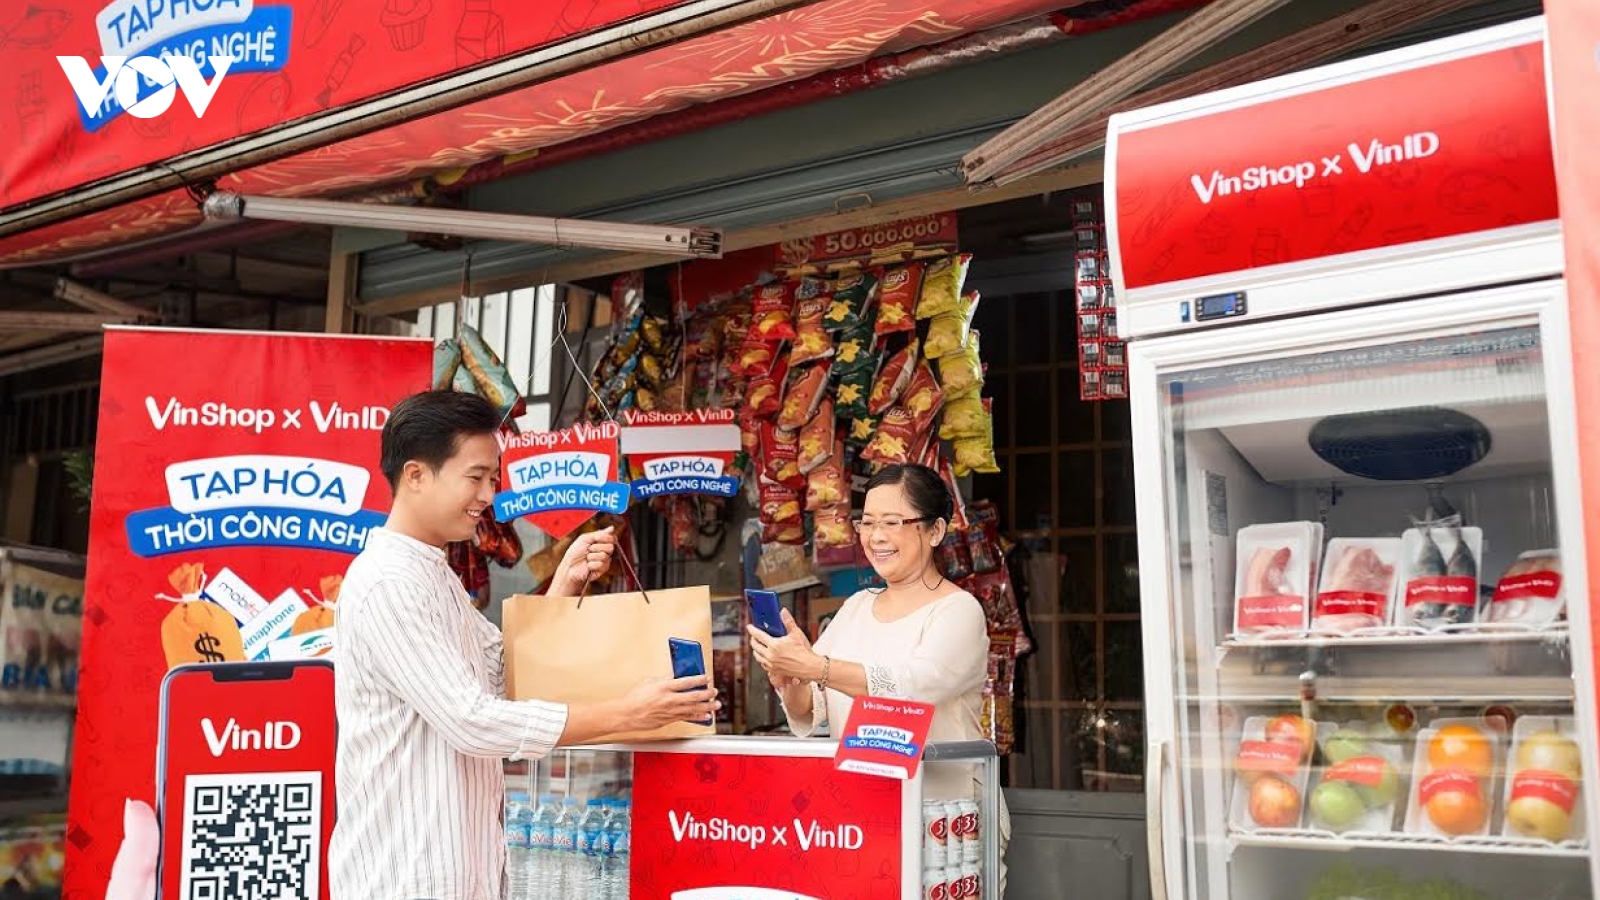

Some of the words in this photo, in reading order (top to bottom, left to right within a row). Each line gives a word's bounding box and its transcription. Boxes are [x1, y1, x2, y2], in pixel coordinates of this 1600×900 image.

[1191, 161, 1315, 204] VinShop
[1322, 155, 1343, 178] x
[1347, 131, 1440, 174] VinID
[145, 396, 275, 433] VinShop
[282, 409, 302, 429] x
[309, 400, 390, 433] VinID
[623, 408, 682, 425] VinShop
[696, 407, 735, 423] VinID
[495, 429, 558, 453] VinShop
[573, 421, 619, 445] VinID
[263, 463, 347, 504] HÓA
[536, 488, 577, 507] CÔNG
[145, 514, 213, 550] THỜI
[220, 511, 302, 540] CÔNG
[309, 518, 368, 549] NGH
[201, 717, 301, 757] VinID
[668, 809, 766, 848] VinShop
[772, 827, 788, 846] x
[792, 818, 864, 851] VinID
